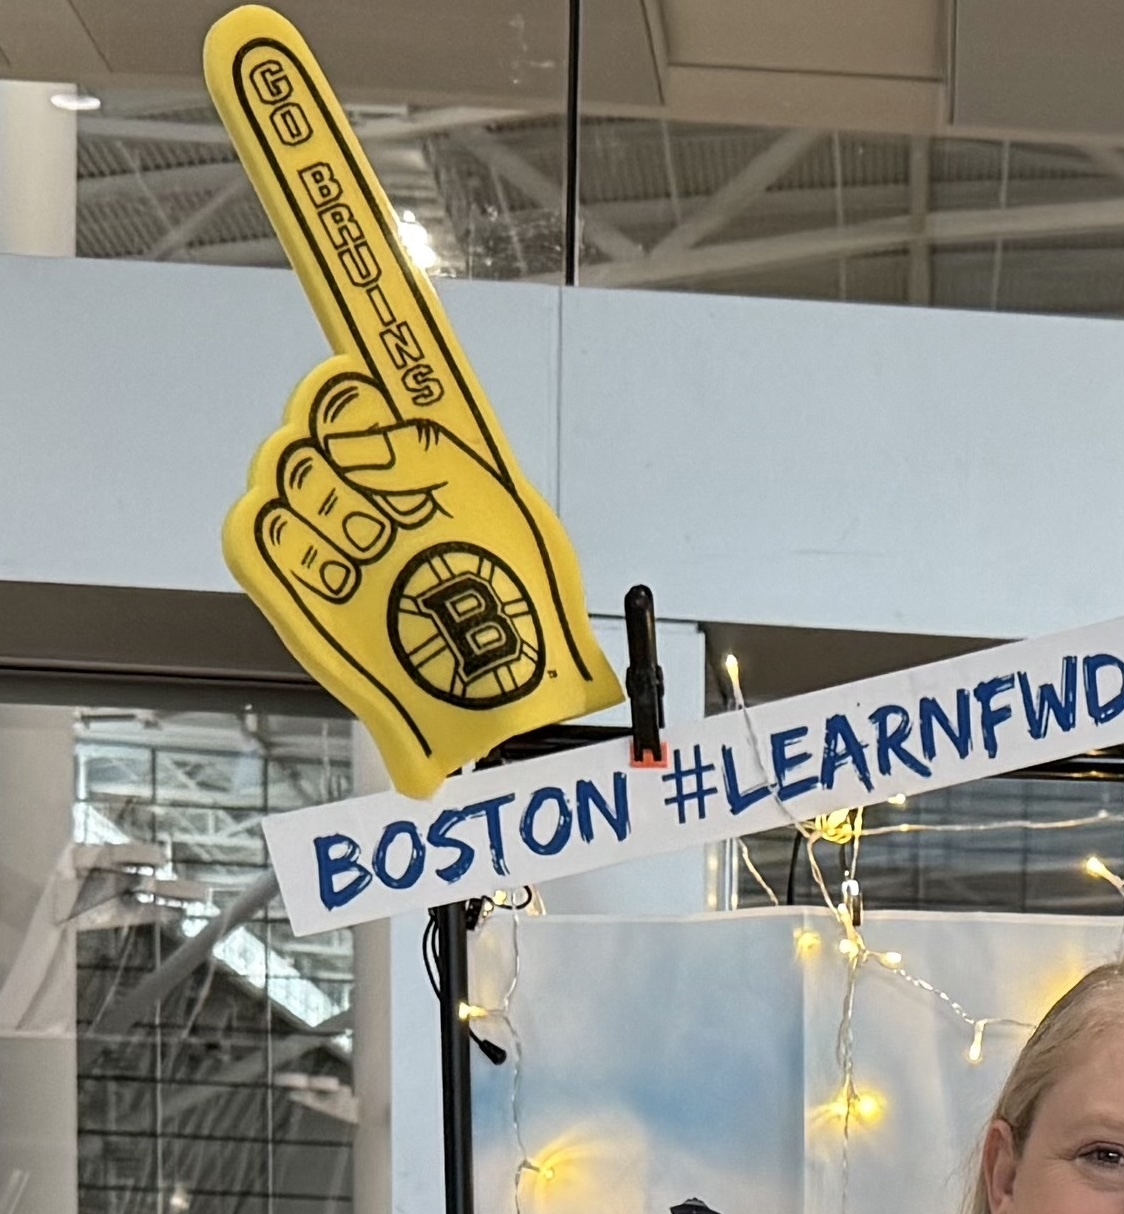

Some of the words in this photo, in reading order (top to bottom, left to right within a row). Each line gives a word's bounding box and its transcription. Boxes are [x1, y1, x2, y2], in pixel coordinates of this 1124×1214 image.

[249, 59, 313, 147] GO
[298, 161, 444, 407] BRUINS
[415, 570, 523, 688] B
[313, 771, 632, 911] BOSTON
